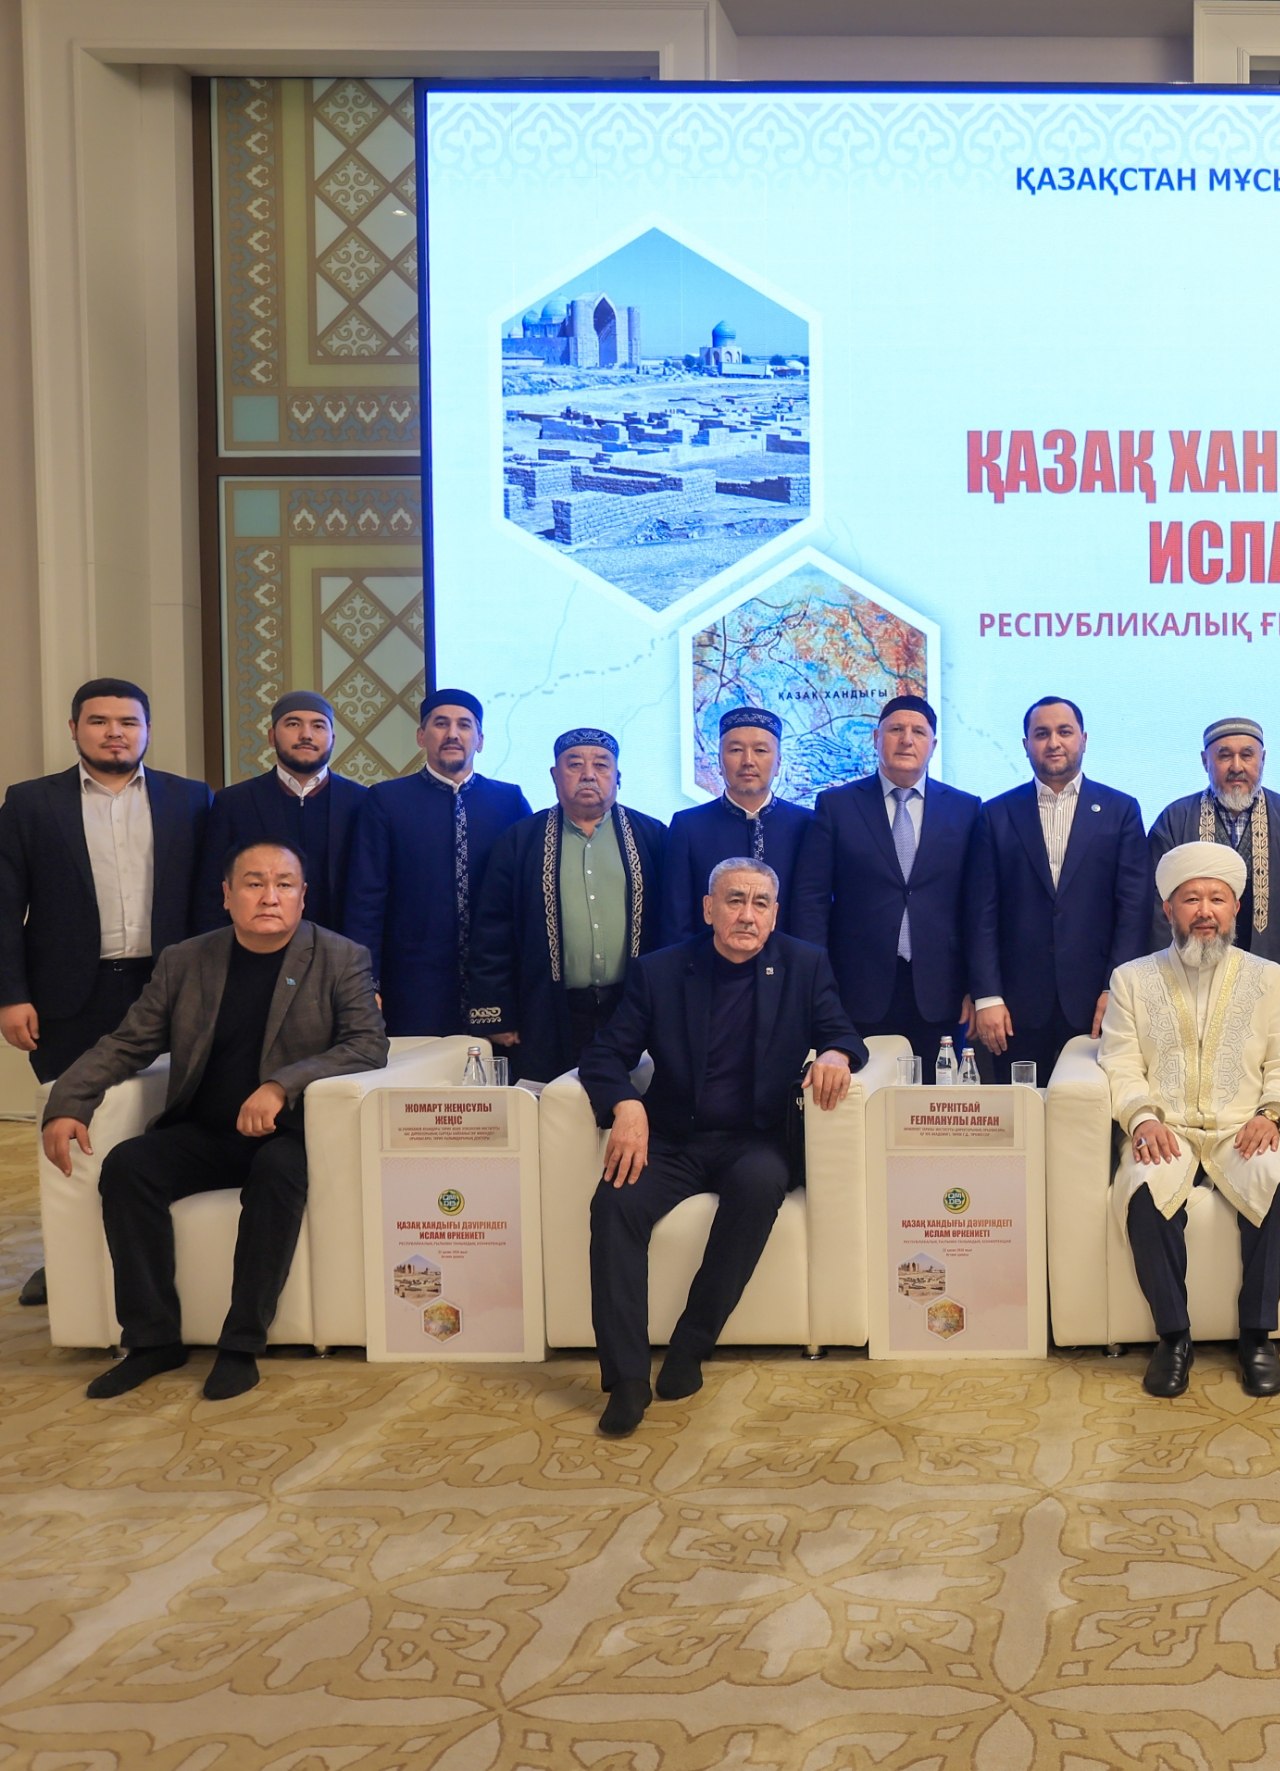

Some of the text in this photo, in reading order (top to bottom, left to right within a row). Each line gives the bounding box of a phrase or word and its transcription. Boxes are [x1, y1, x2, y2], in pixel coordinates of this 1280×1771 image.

[1016, 166, 1197, 197] ҚАЗАҚСТАН
[966, 428, 1157, 505] ҚАЗАҚ
[979, 611, 1253, 644] РЕСПУБЛИКАЛЫҚ
[824, 689, 888, 700] ХАНДЫҒЫ
[405, 1103, 442, 1113] ЖОМАРТ
[930, 1101, 980, 1112] БҮРКІТБАЙ
[435, 1116, 462, 1126] ЖЕҢІС
[970, 1116, 1000, 1126] АЯҒАН
[902, 1220, 926, 1228] ҚАЗАҚ
[420, 1232, 446, 1240] ИСЛАМ
[924, 1230, 950, 1238] ИСЛАМ
